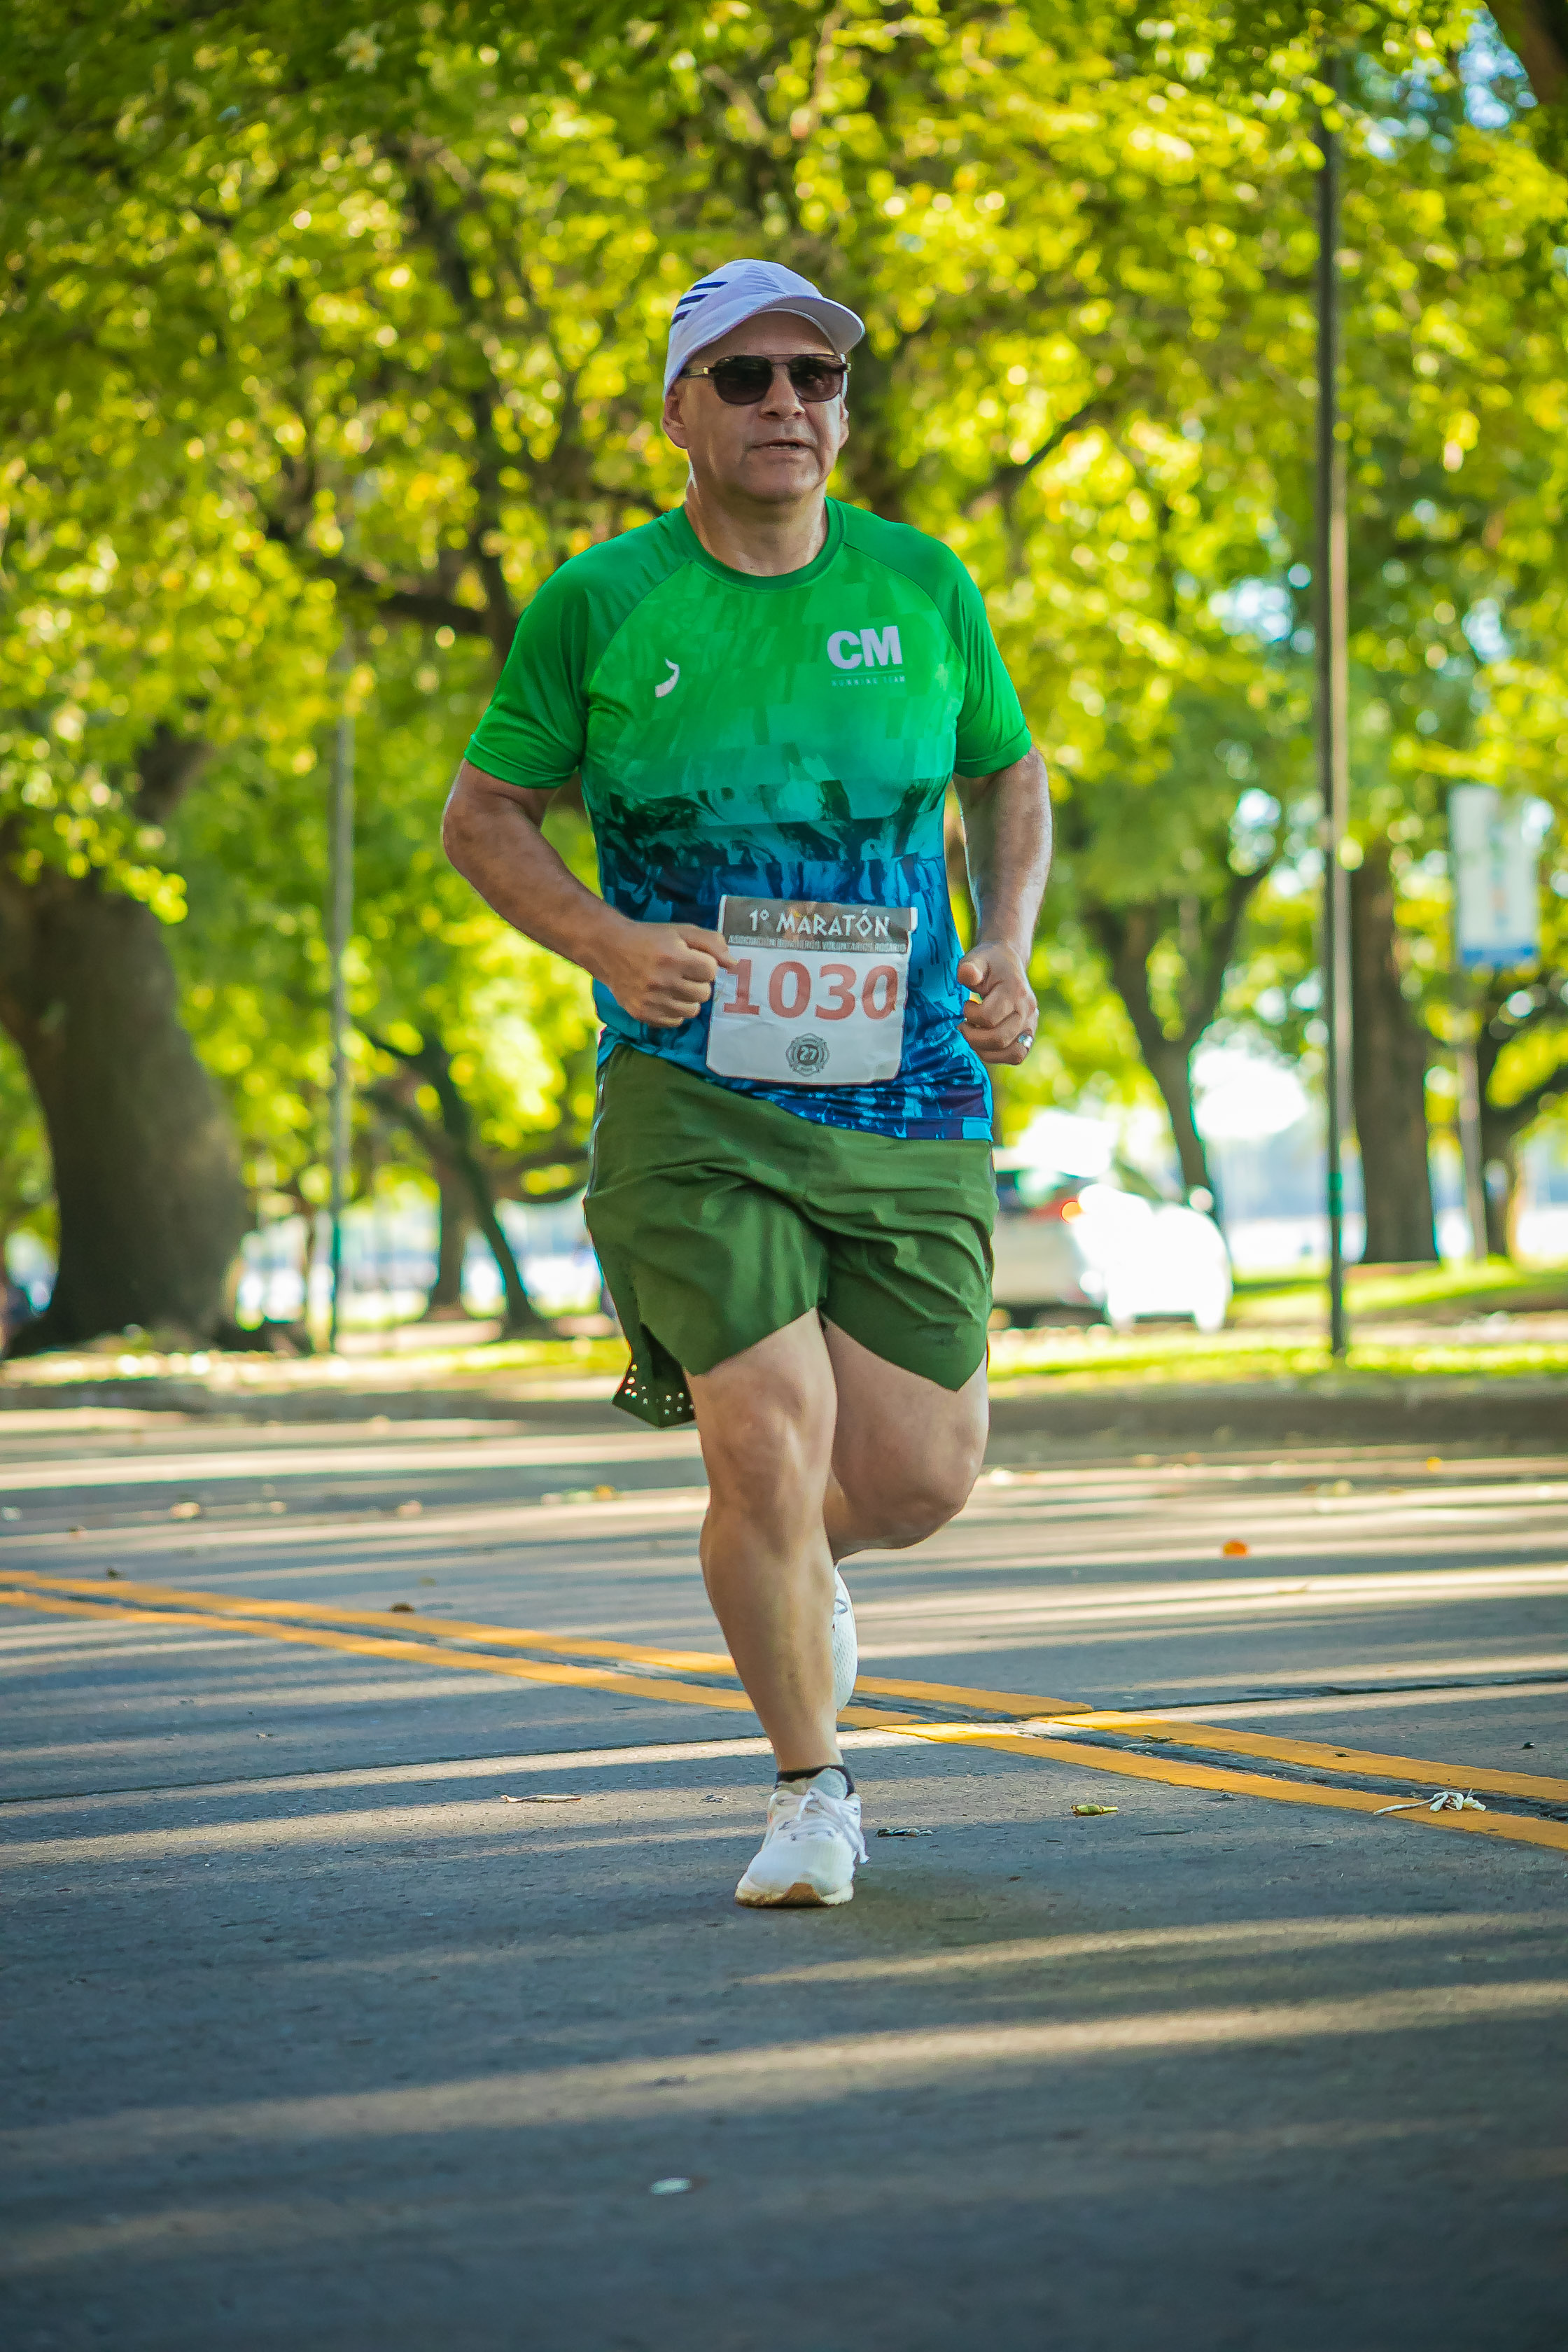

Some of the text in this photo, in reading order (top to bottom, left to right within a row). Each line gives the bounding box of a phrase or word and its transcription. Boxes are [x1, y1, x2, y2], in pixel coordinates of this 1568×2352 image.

[827, 625, 902, 669] CM
[776, 909, 890, 937] MARATÓN
[723, 958, 899, 1021] 1030
[800, 1046, 818, 1060] 27
